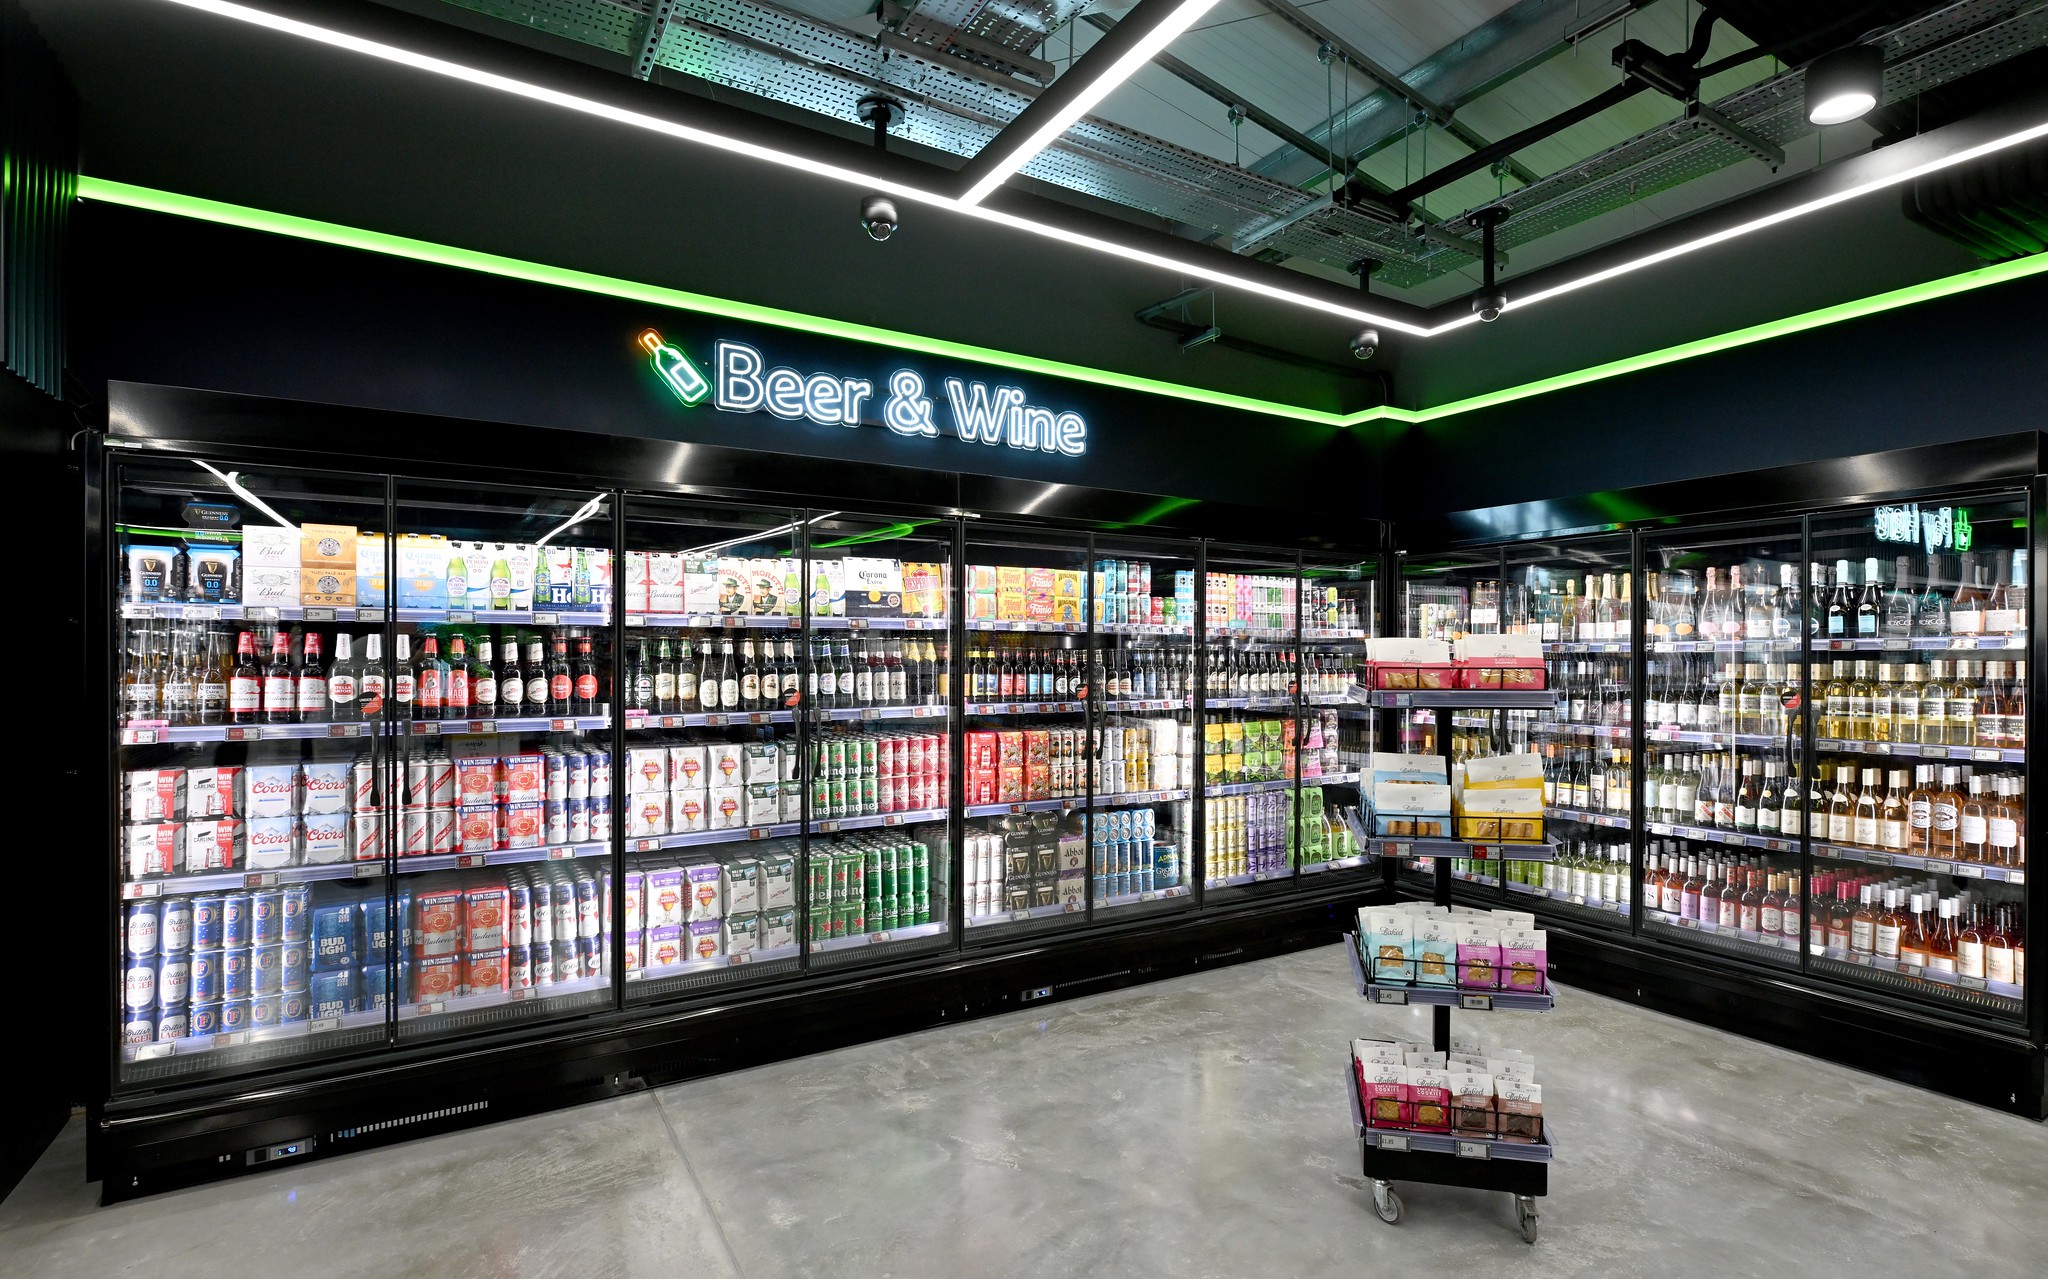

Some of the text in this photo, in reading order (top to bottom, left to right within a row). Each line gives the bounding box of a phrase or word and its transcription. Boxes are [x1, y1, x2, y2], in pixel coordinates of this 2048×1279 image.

[715, 340, 1087, 457] Beer & Wine
[257, 546, 286, 556] Bud
[405, 551, 442, 560] Corona
[858, 570, 888, 579] Corona
[144, 579, 158, 587] 0.0
[206, 581, 219, 589] 0.0
[718, 569, 752, 595] MORETTI
[752, 570, 786, 596] MORETTI
[257, 588, 286, 597] Bud
[650, 588, 683, 598] Budweiser
[1494, 774, 1516, 782] Bakery
[252, 782, 291, 793] Coors
[307, 779, 346, 791] Coors
[251, 833, 290, 845] Coors
[306, 829, 345, 841] Coors
[1064, 848, 1084, 857] Abbot
[1035, 870, 1057, 878] GUINNESS
[1063, 886, 1082, 895] Abbot
[424, 896, 437, 905] WIN
[168, 917, 190, 926] British
[1380, 926, 1404, 937] Baked
[320, 936, 345, 947] BUD
[1465, 937, 1488, 947] Baked
[1509, 940, 1535, 950] Baked
[472, 952, 484, 960] WIN
[421, 958, 435, 966] WIN
[319, 1000, 344, 1011] BUD
[126, 1028, 151, 1036] British
[161, 1024, 186, 1032] British
[125, 1034, 152, 1043] LAGER
[160, 1029, 186, 1038] LAGER
[1374, 1075, 1399, 1085] Baked
[1416, 1078, 1442, 1088] Baked
[1460, 1086, 1485, 1096] Baked
[1505, 1091, 1531, 1102] Baked
